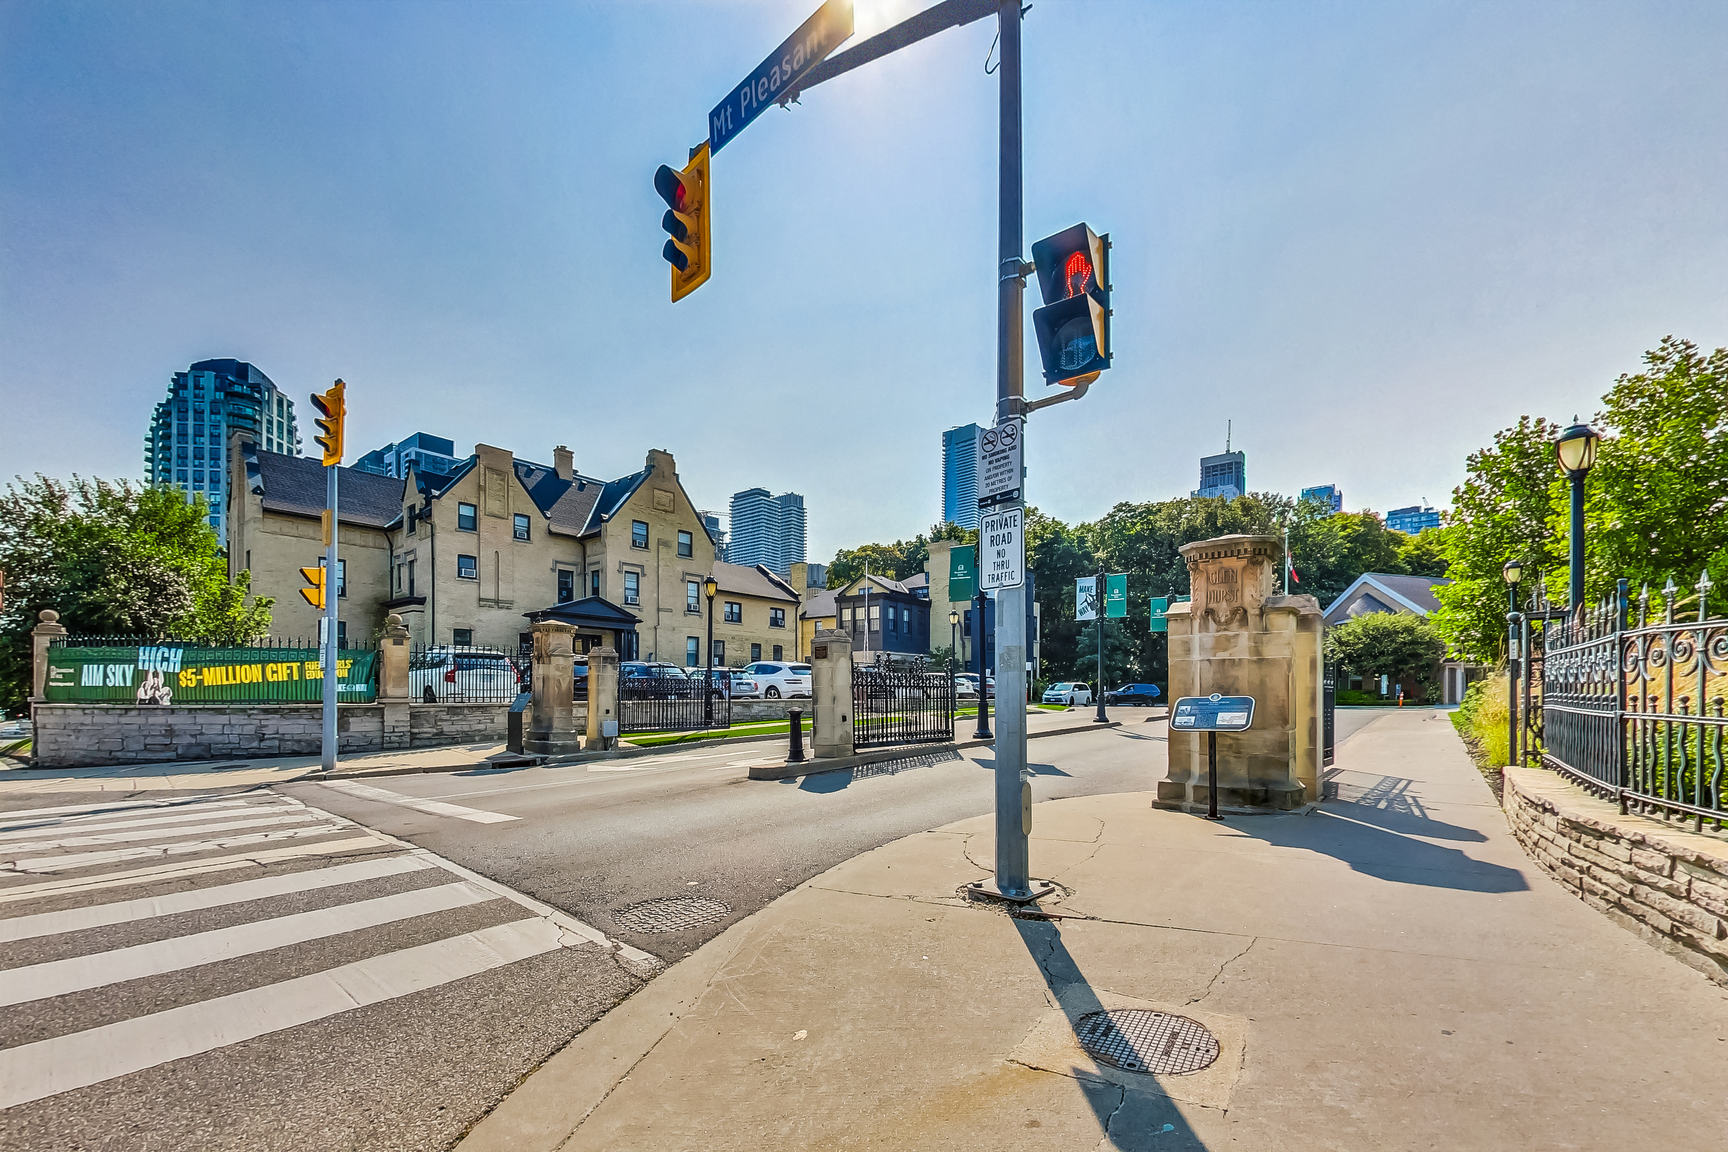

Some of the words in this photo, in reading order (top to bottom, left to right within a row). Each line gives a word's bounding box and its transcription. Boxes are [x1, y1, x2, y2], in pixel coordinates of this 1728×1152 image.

[713, 104, 733, 143] Mt
[740, 17, 828, 118] Pleasant
[988, 447, 1007, 458] SMOKING
[1008, 444, 1017, 452] AND
[992, 461, 1013, 472] PROPERTY
[984, 472, 999, 481] AND/OR
[1000, 468, 1014, 477] WITHIN
[991, 477, 1007, 487] METRES
[989, 484, 1009, 494] PROPERTY
[985, 515, 1018, 533] PRIVATE
[990, 532, 1013, 547] ROAD
[996, 549, 1006, 559] NO
[993, 559, 1010, 571] THRU
[988, 571, 1015, 583] TRAFFIC
[1209, 570, 1238, 585] GLEN
[1079, 585, 1094, 593] MAKE
[1207, 588, 1239, 604] HURST
[1078, 605, 1089, 617] WAY
[138, 646, 183, 673] HIGH
[81, 664, 104, 687] AIM
[106, 664, 135, 687] SKY
[178, 664, 262, 688] $5-MILLION
[265, 662, 301, 682] GIFT
